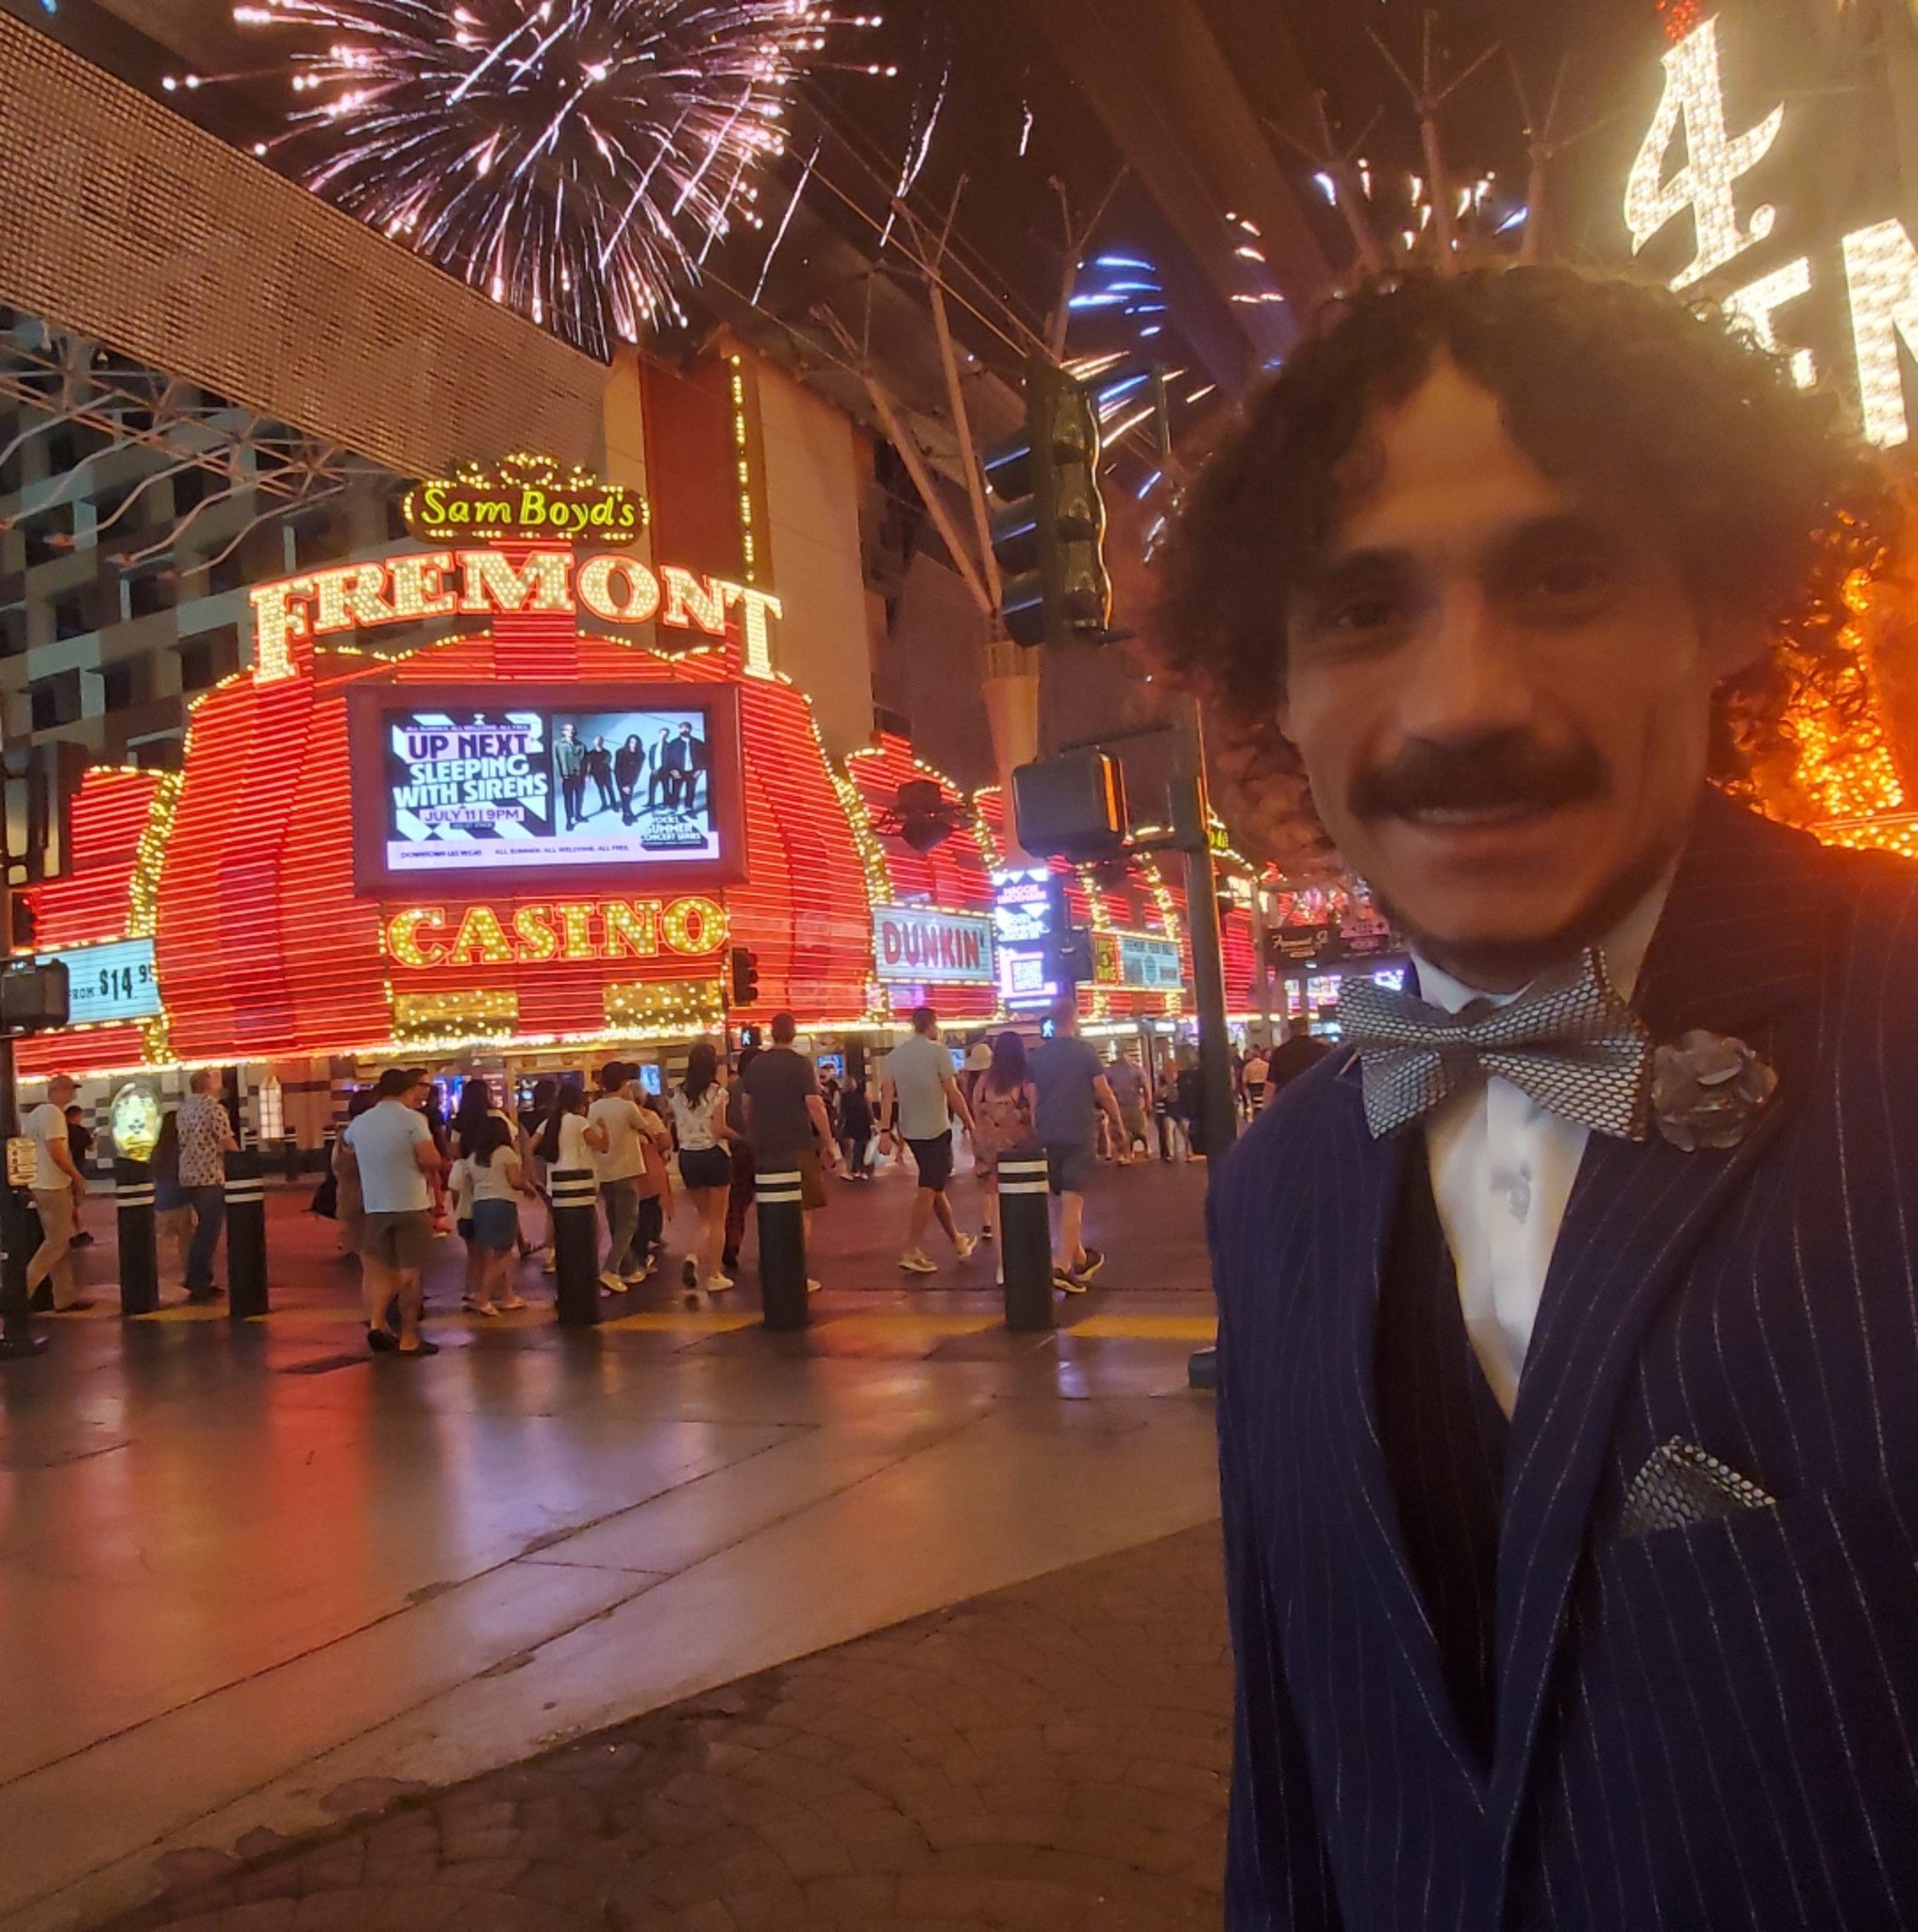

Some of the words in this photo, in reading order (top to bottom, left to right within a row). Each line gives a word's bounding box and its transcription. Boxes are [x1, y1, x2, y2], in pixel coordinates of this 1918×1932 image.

[1624, 12, 1785, 294] 4
[421, 486, 510, 525] Sam
[519, 490, 636, 532] Boyd's
[249, 549, 783, 685] FREMONT
[408, 734, 449, 759] UP
[459, 733, 528, 759] NEXT
[409, 754, 530, 786] SLEEPING
[392, 781, 459, 809] WITH
[463, 773, 549, 803] SIRENS
[425, 811, 460, 822] JULY
[464, 810, 475, 821] 11
[488, 809, 520, 820] 9PM
[387, 896, 729, 969] CASINO
[882, 920, 985, 970] DUNKIN'
[70, 987, 94, 1001] ROM
